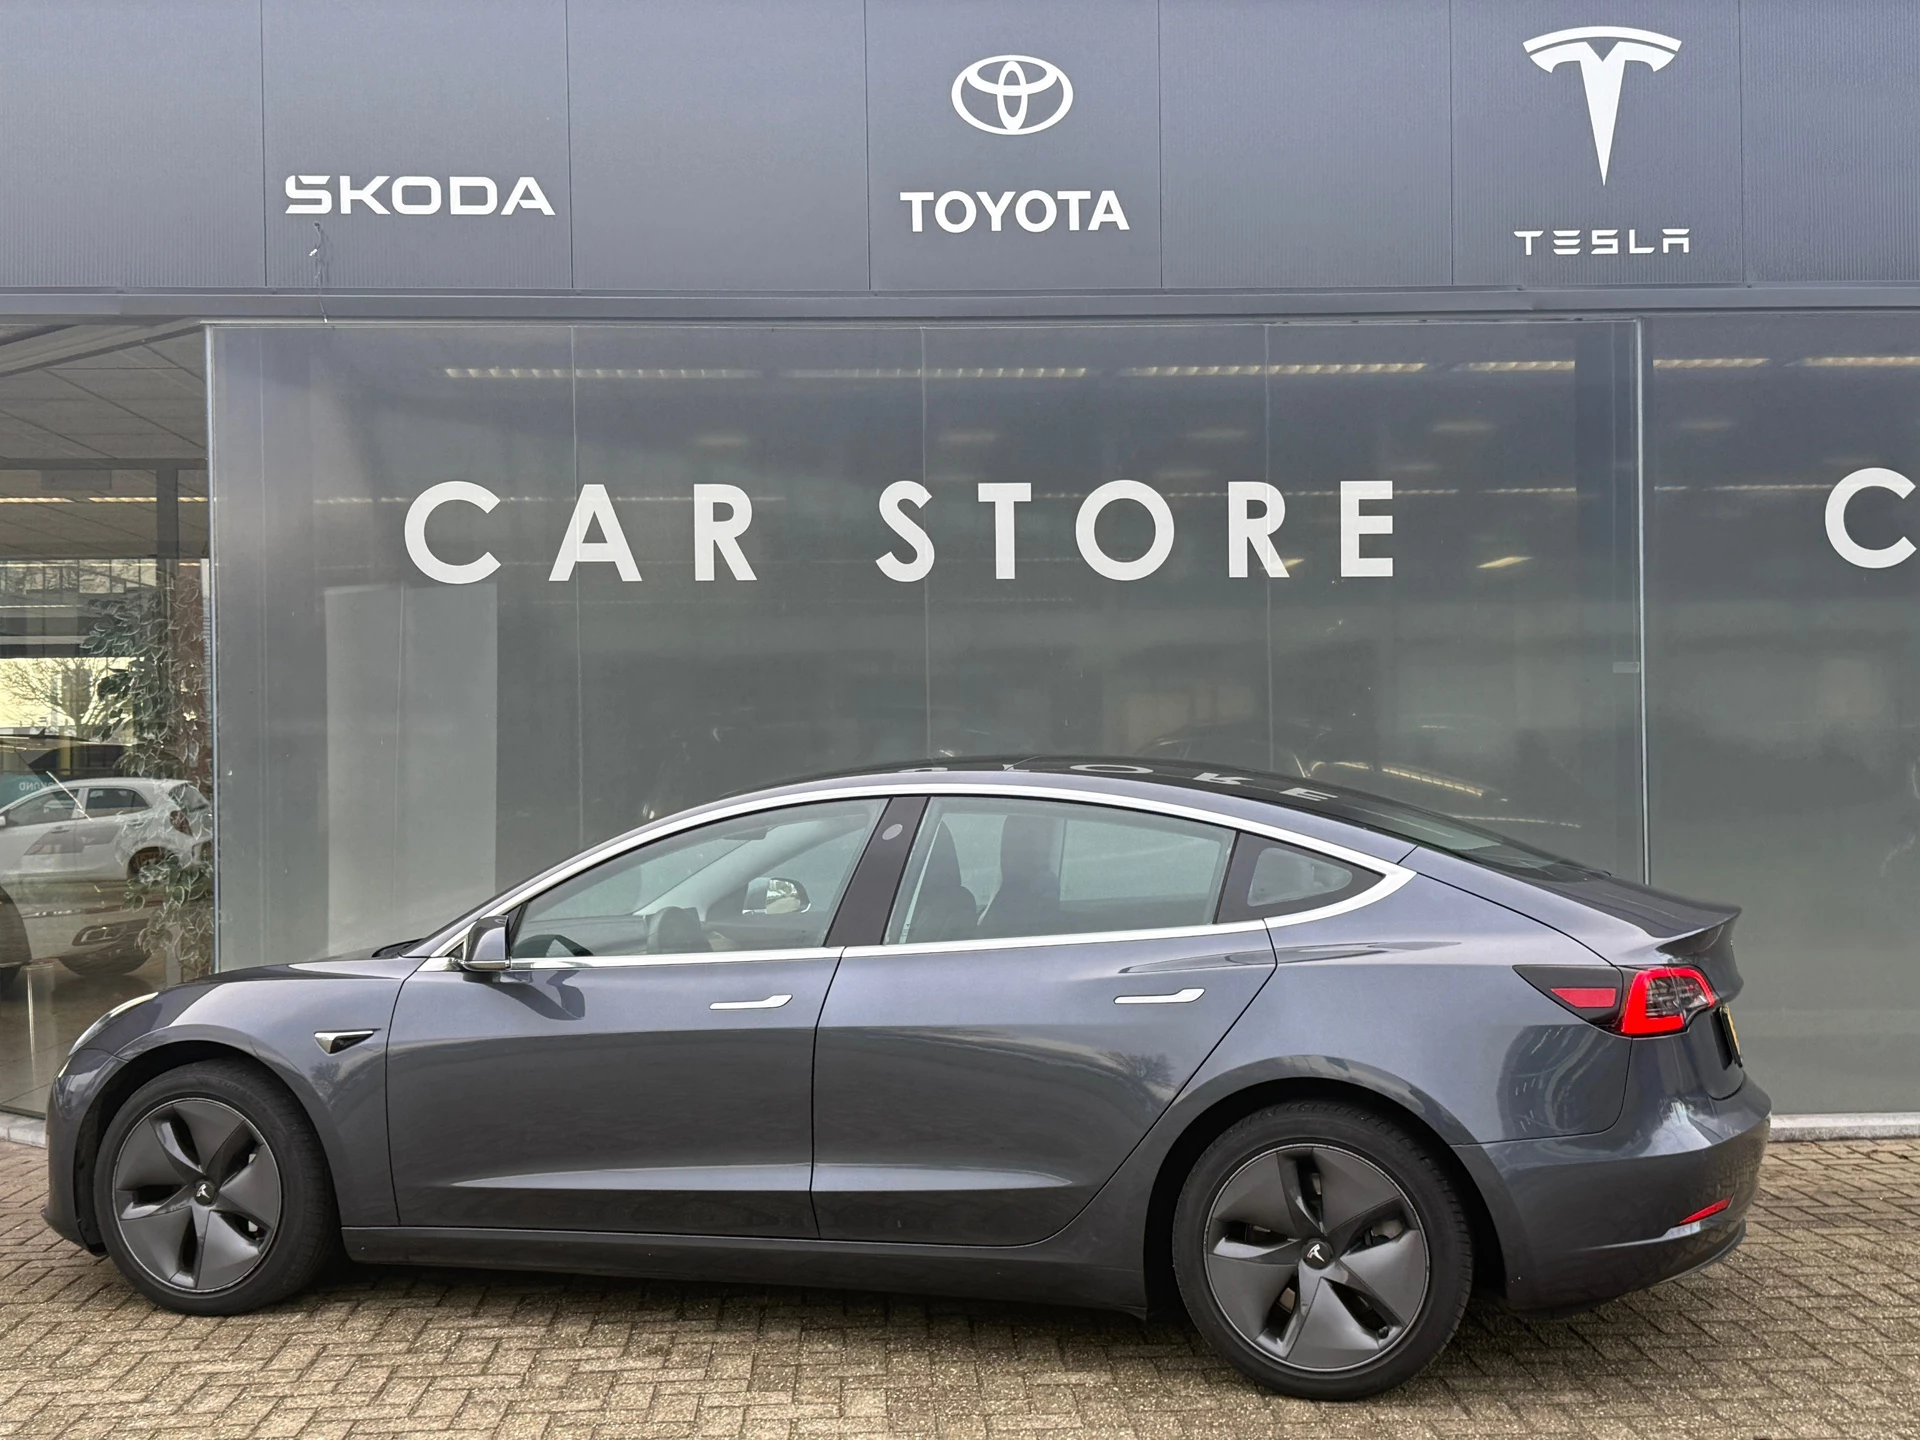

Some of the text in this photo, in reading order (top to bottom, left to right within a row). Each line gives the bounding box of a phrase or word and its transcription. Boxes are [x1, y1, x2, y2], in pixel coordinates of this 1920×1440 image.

[899, 189, 1130, 234] TOYOTA
[1513, 228, 1690, 256] TESLA
[404, 479, 1393, 585] CAR STORE
[1825, 467, 1917, 569] C
